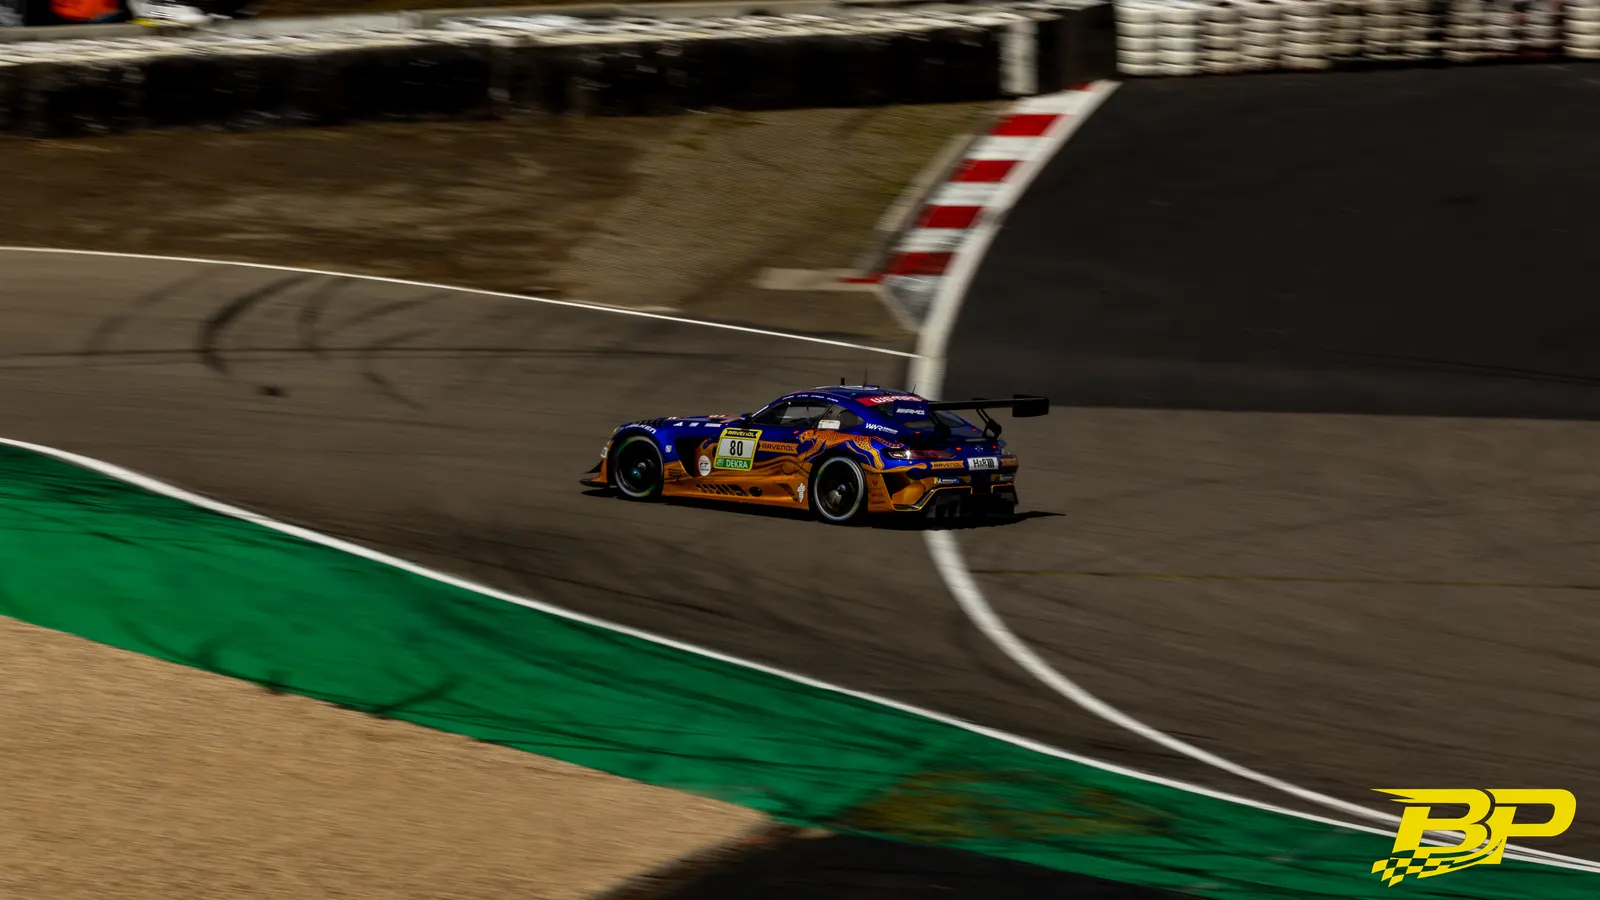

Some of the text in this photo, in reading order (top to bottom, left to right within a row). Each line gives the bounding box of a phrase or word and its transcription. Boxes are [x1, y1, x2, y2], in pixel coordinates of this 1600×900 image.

[729, 440, 743, 457] 80
[762, 443, 795, 451] RAVENOL
[726, 459, 749, 469] DEKRA
